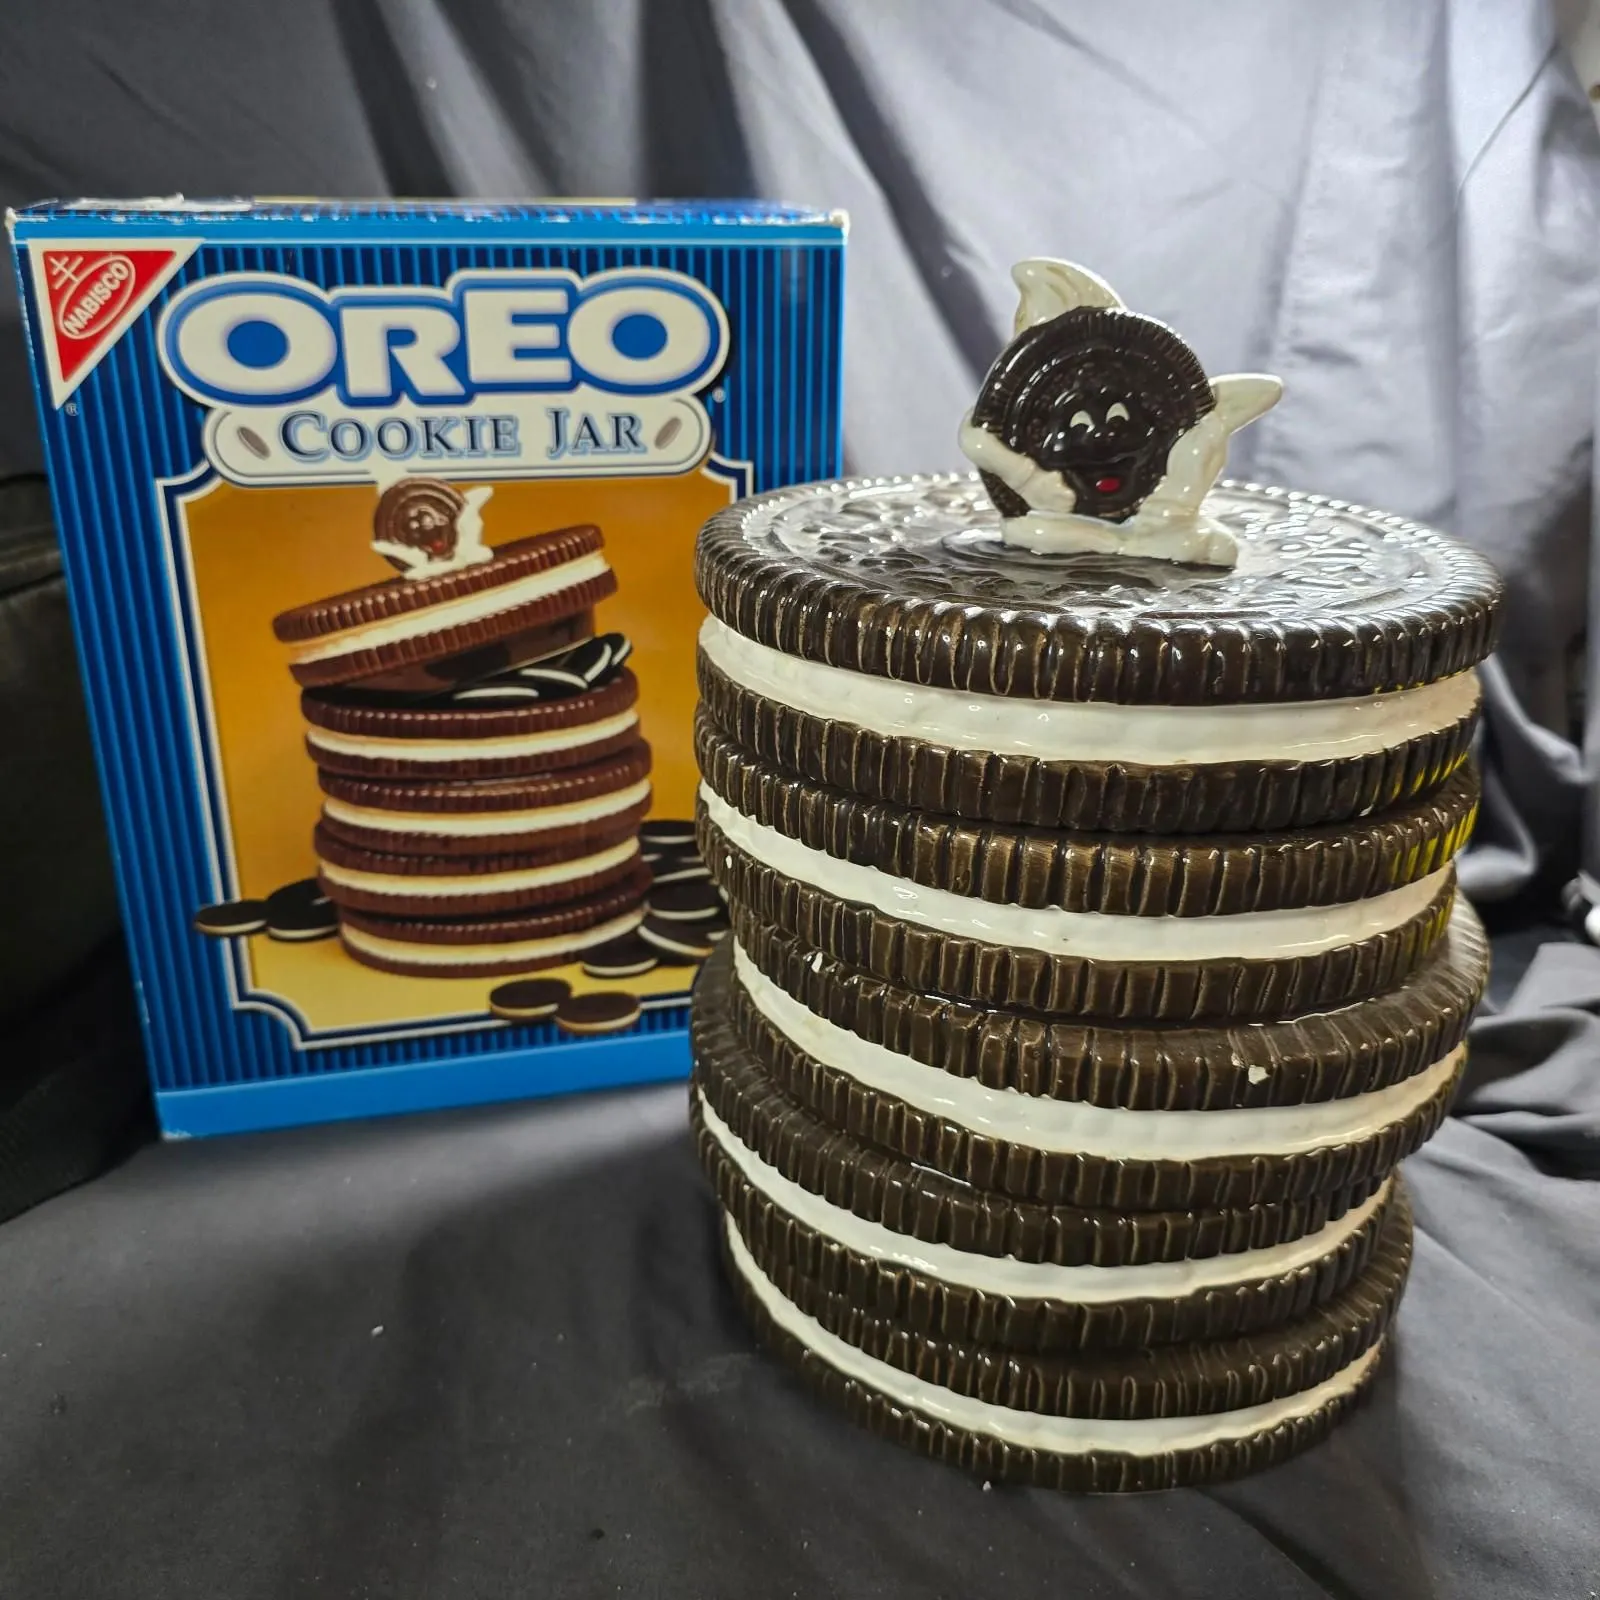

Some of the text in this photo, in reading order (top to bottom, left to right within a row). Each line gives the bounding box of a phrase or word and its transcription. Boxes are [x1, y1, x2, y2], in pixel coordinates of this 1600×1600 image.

[63, 261, 129, 336] NABISCO
[178, 286, 711, 398] OREO
[279, 407, 648, 462] COOKIE JAR
